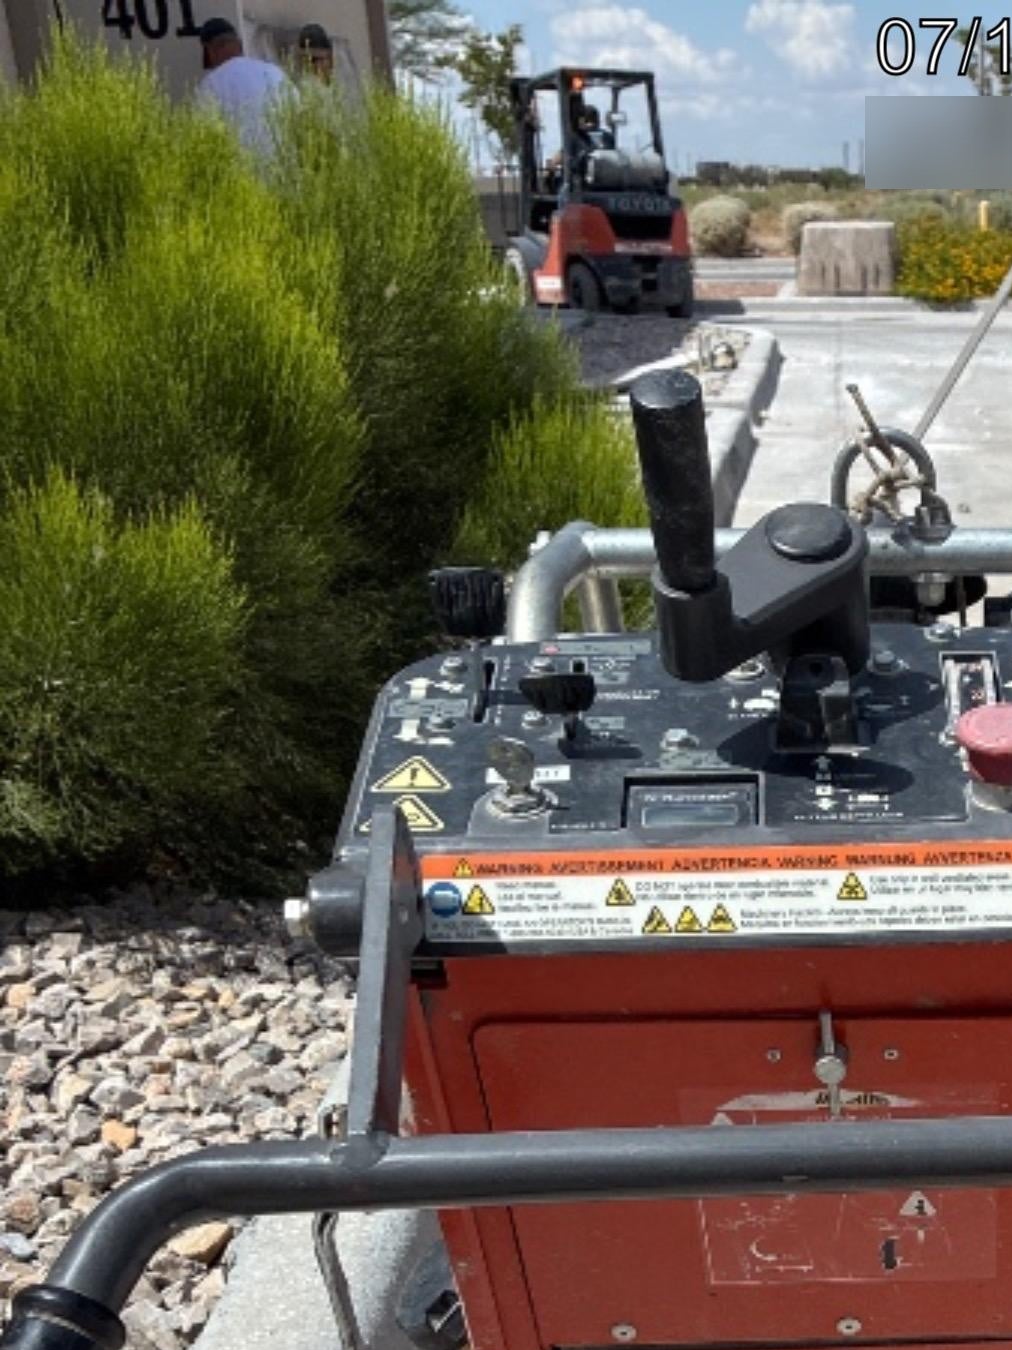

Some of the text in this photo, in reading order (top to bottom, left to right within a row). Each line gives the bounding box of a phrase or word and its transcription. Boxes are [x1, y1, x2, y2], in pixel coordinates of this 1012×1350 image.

[102, 0, 202, 39] 401
[609, 197, 671, 210] TOYOTA
[476, 863, 543, 876] WARNING
